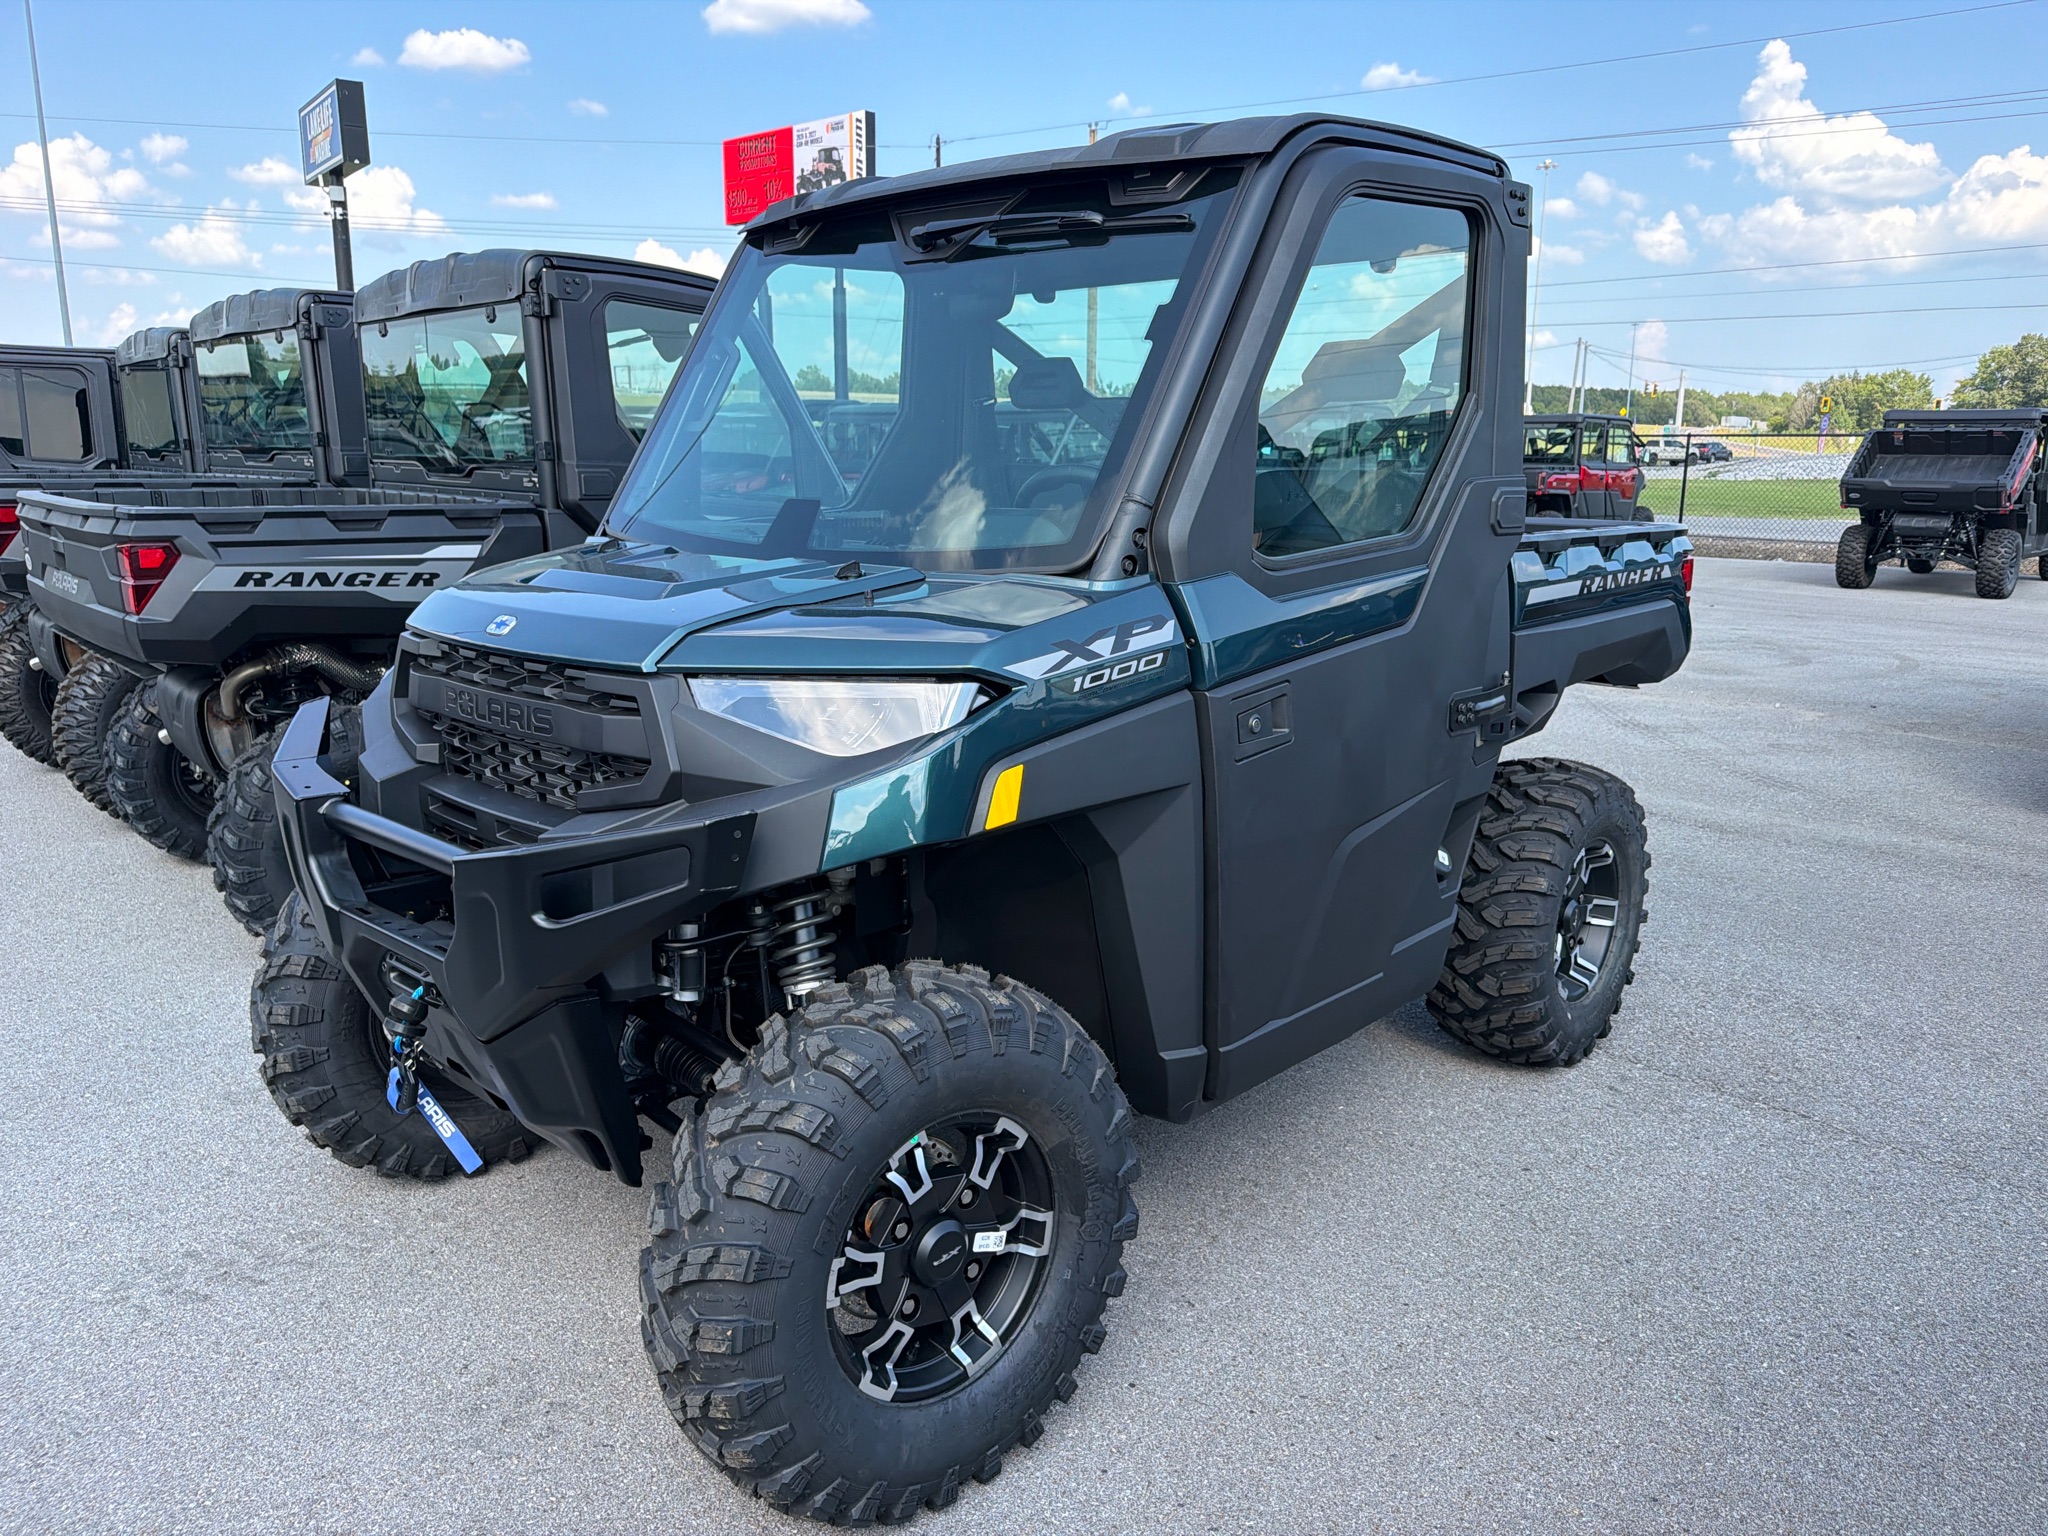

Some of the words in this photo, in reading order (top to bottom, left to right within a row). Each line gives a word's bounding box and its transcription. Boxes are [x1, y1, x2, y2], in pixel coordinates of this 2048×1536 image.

[738, 134, 776, 158] CURRENT
[738, 153, 777, 172] PROMOTIONS
[727, 188, 747, 207] $500
[763, 178, 783, 200] 10%
[52, 571, 79, 595] POLARIS
[233, 571, 441, 588] RANGER
[1578, 564, 1666, 595] RANGER
[1040, 614, 1170, 676] XP
[1073, 652, 1164, 693] 1000
[1077, 690, 1100, 701] DUAL
[443, 686, 554, 737] POLARIS
[417, 1085, 456, 1138] LARIS
